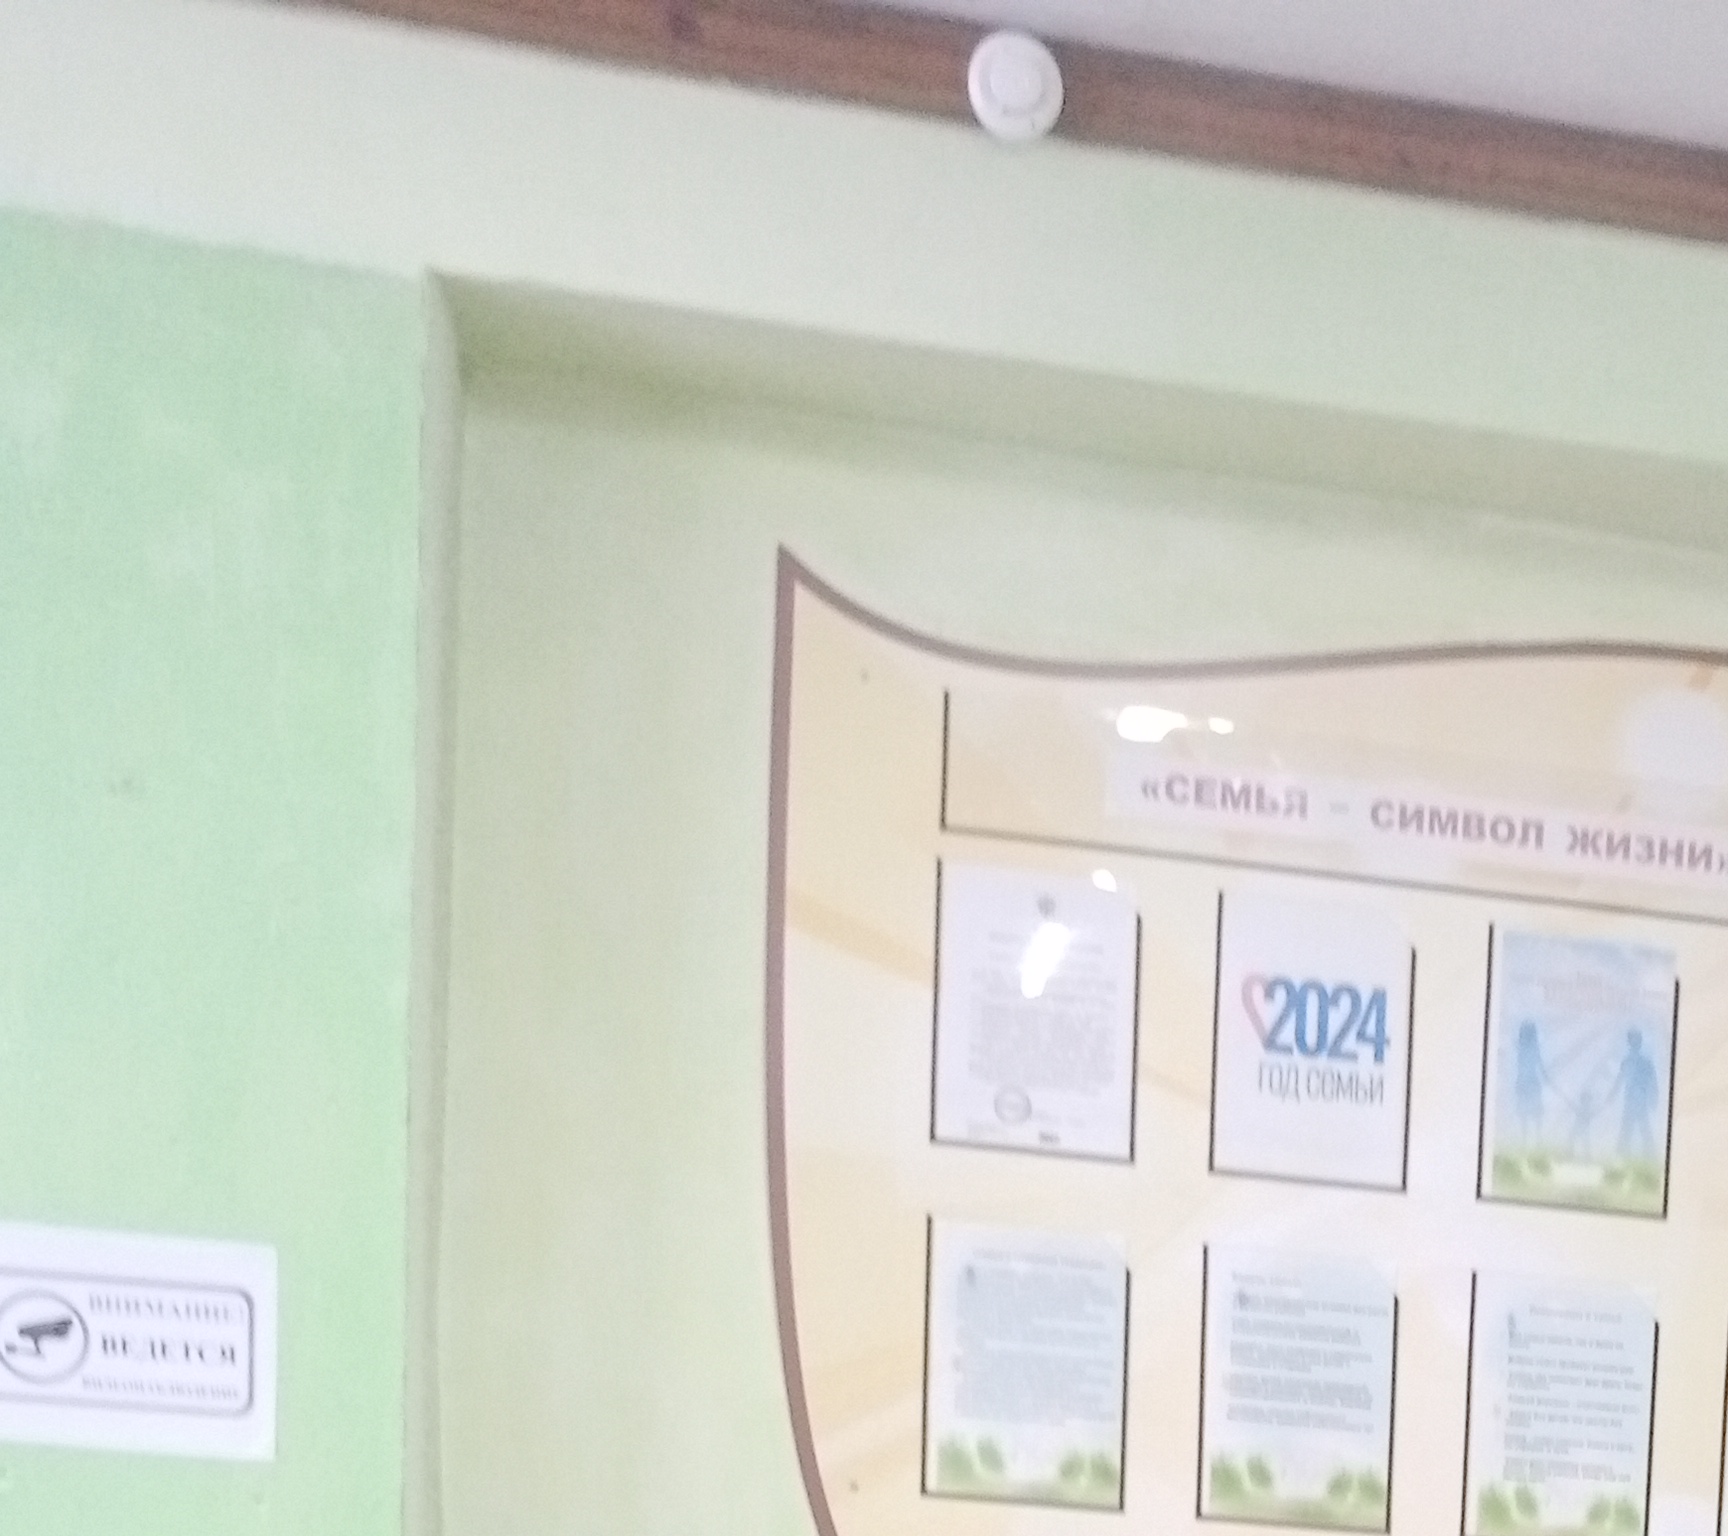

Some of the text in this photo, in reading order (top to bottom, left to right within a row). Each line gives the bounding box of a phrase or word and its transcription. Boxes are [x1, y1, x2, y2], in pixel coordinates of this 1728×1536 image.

[1141, 772, 1309, 819] «СЕМЬЯ
[1370, 797, 1545, 850] СИМВОЛ
[1263, 977, 1391, 1064] 2024
[1259, 1061, 1300, 1104] ГОД
